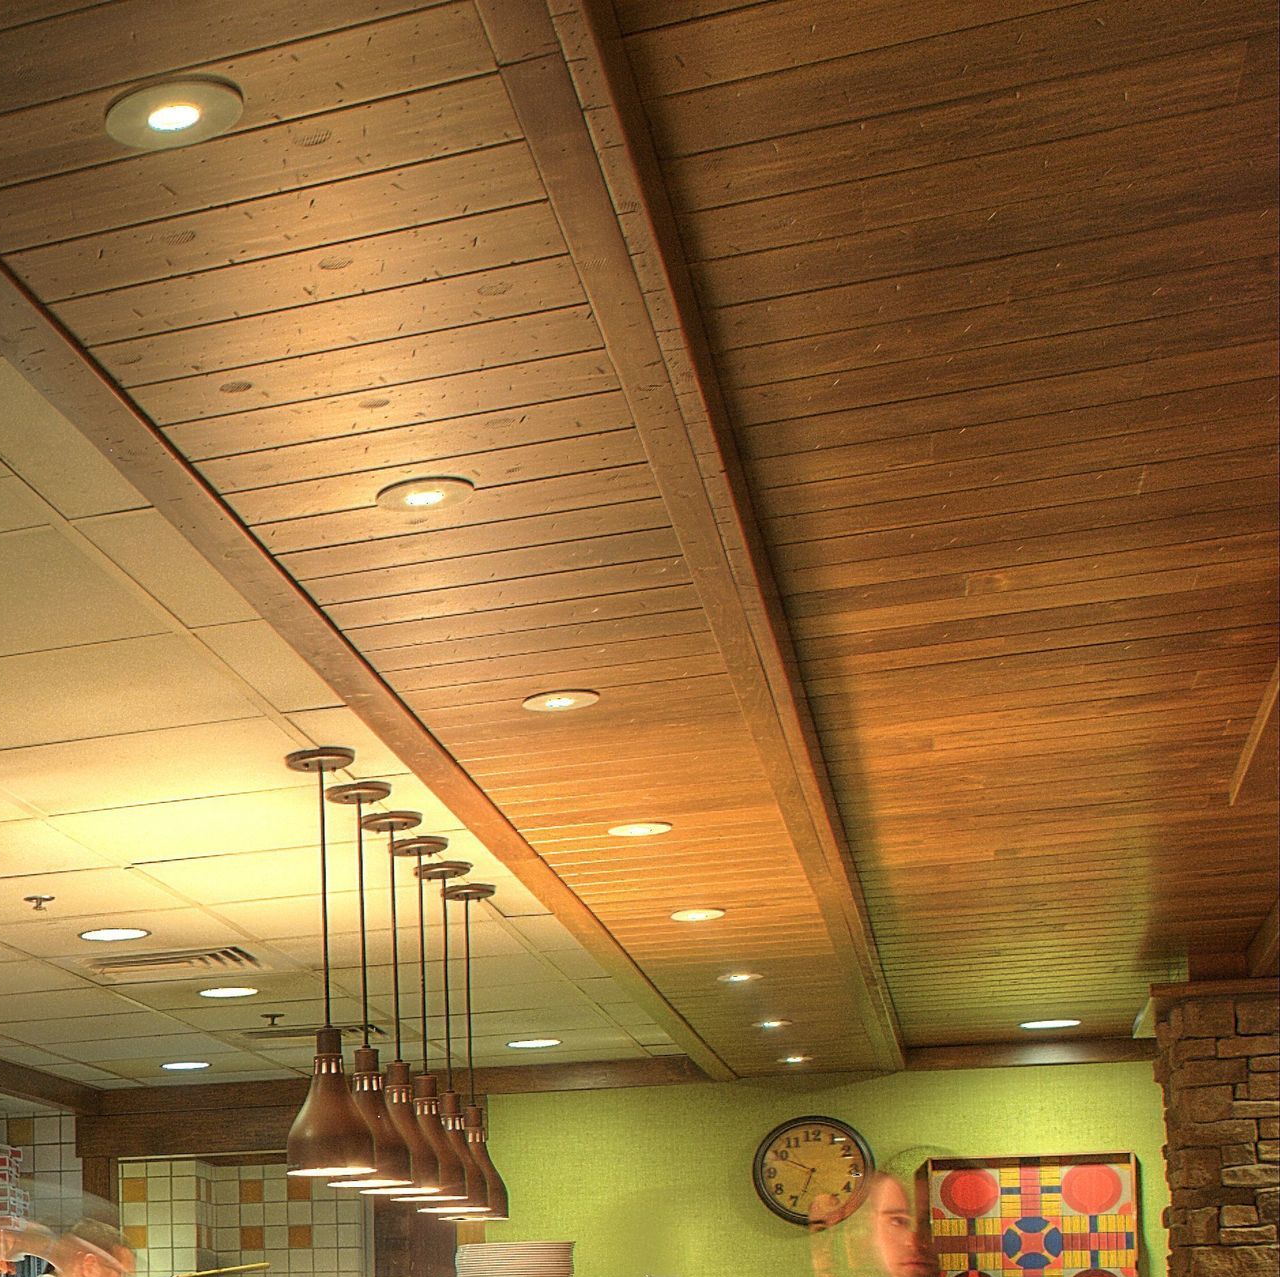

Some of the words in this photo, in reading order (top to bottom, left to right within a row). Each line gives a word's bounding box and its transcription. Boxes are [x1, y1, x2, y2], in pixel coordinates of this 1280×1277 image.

[803, 1129, 821, 1142] 12
[785, 1137, 800, 1148] 11
[841, 1144, 852, 1157] 2
[766, 1167, 777, 1179] 9
[774, 1183, 784, 1195] 8
[841, 1180, 851, 1192] 4
[789, 1195, 798, 1207] 7
